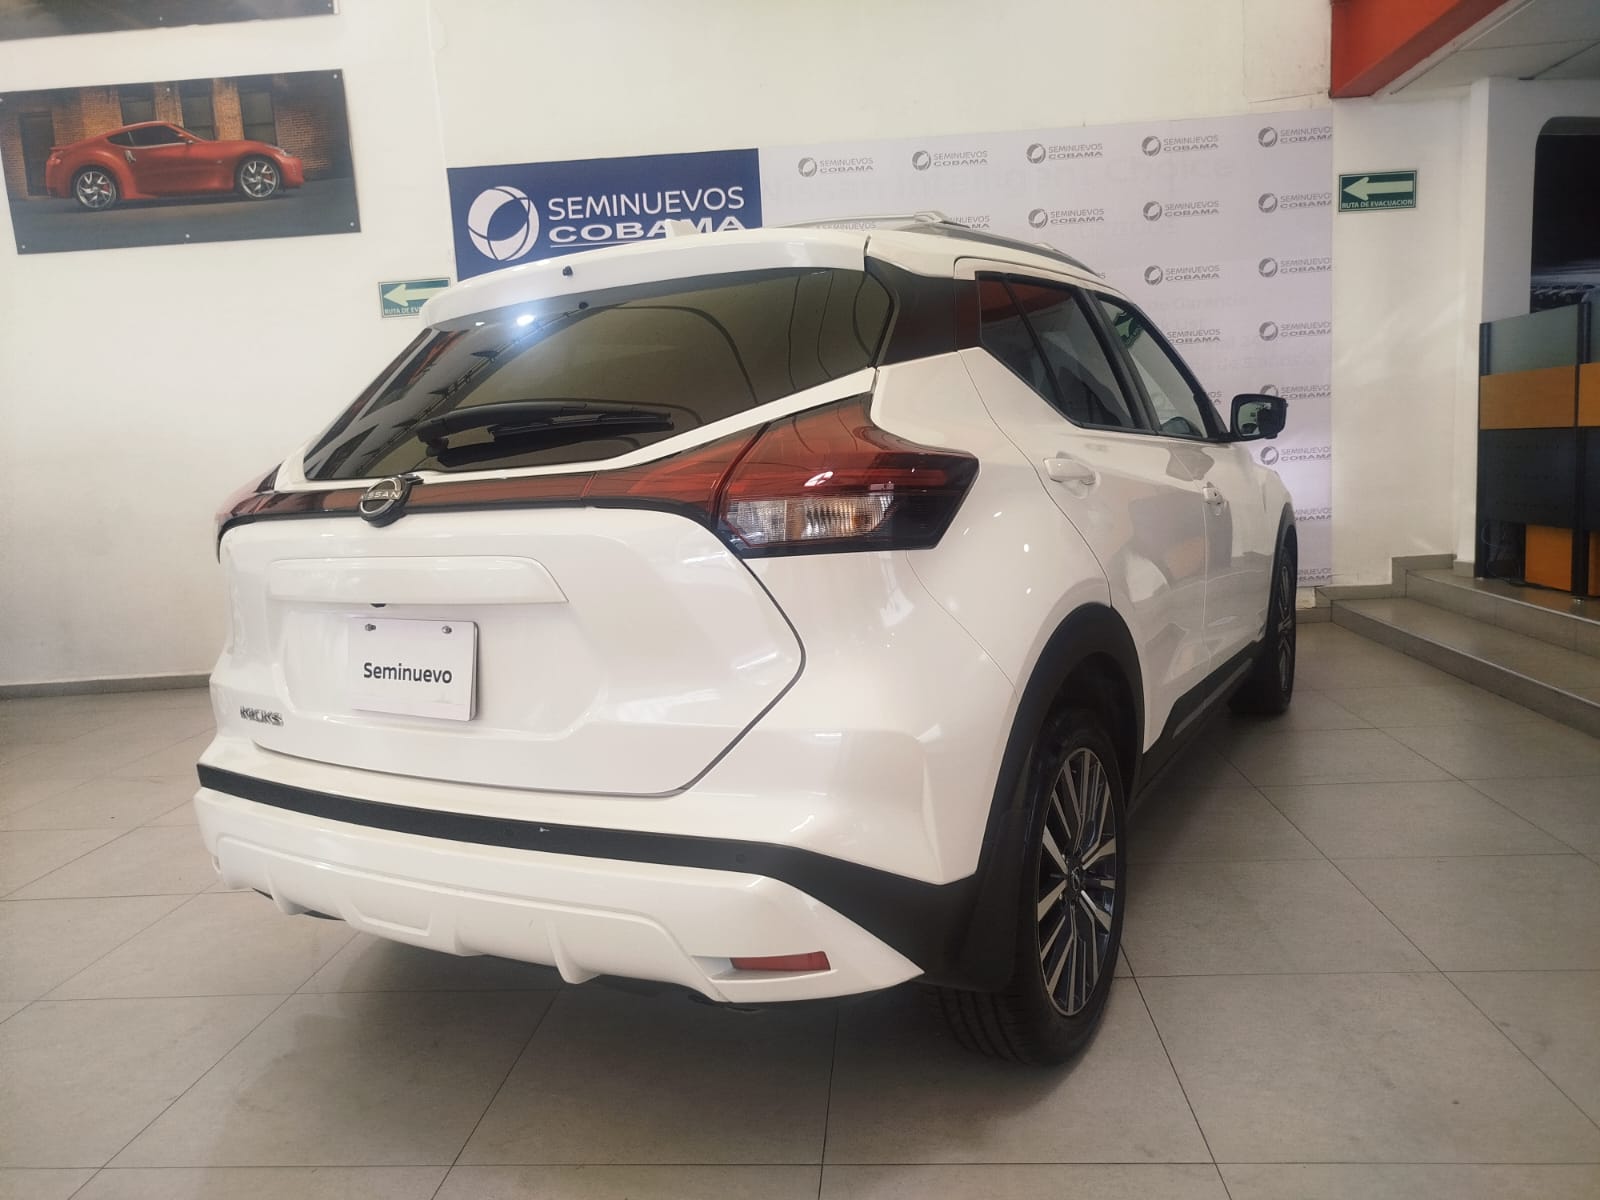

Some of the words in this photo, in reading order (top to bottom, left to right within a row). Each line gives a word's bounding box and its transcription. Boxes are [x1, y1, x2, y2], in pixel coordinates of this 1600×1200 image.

[1163, 134, 1219, 146] SEMINUEVOS
[1048, 143, 1103, 154] SEMINUEVOS
[1163, 143, 1219, 152] COBAMA
[933, 150, 988, 161] SEMINUEVOS
[1048, 151, 1103, 160] COBAMA
[820, 157, 874, 168] SEMINUEVOS
[933, 158, 988, 166] COBAMA
[820, 165, 874, 173] COBAMA
[548, 186, 745, 221] SEMINUEVOS
[1165, 200, 1219, 211] SEMINUEVOS
[1341, 201, 1359, 209] RUTA
[1360, 200, 1370, 208] DE
[1050, 208, 1104, 219] SEMINUEVOS
[1165, 208, 1219, 217] COBAMA
[1050, 216, 1104, 225] COBAMA
[1165, 264, 1220, 275] SEMINUEVOS
[1165, 272, 1220, 281] COBAMA
[1167, 328, 1221, 338] SEMINUEVOS
[363, 662, 453, 684] Seminuevo
